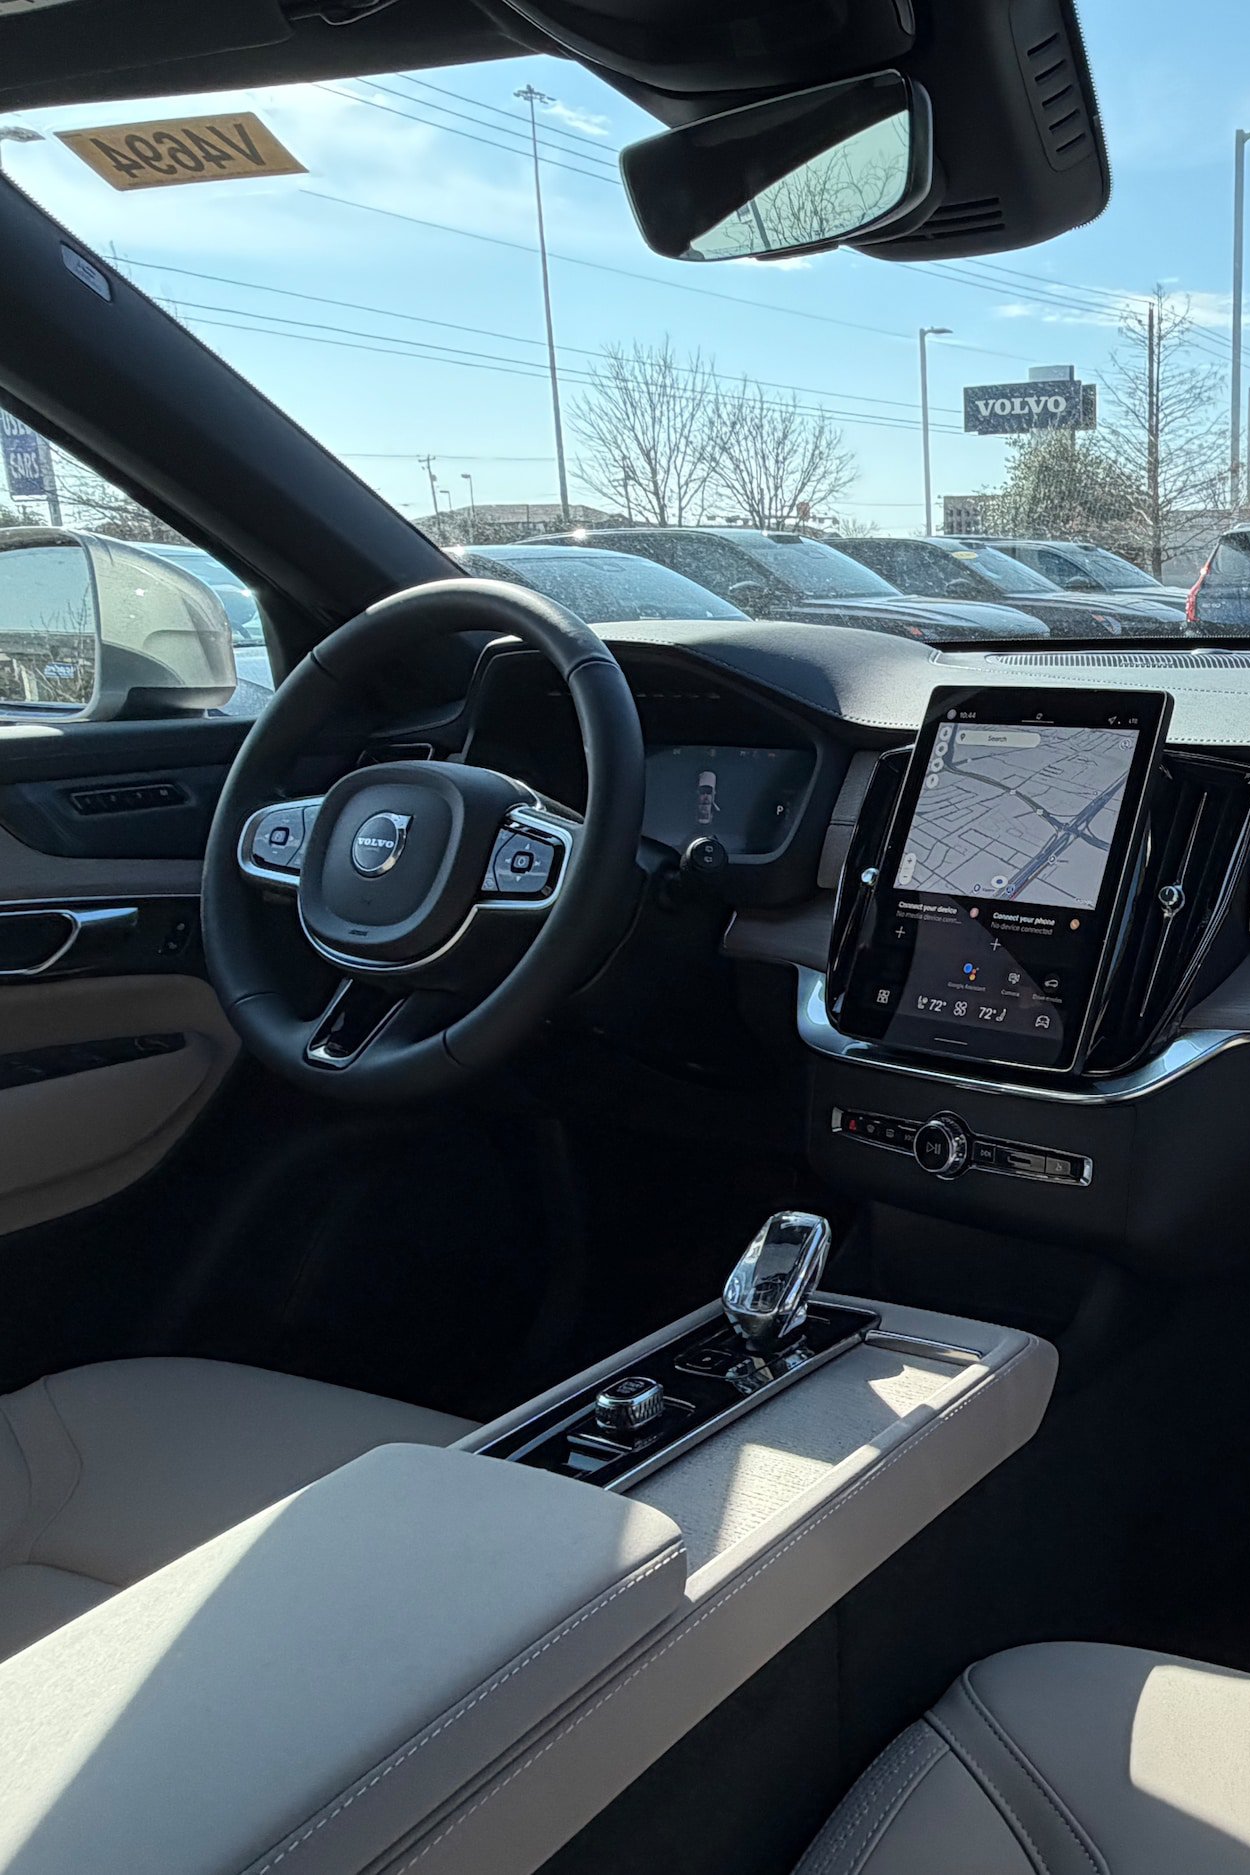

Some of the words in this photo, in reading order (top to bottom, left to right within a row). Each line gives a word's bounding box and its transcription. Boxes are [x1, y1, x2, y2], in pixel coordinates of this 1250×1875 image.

[975, 395, 1067, 417] VOLVO
[2, 412, 31, 436] USE
[9, 452, 40, 479] CARS
[988, 735, 1008, 743] Search
[776, 805, 784, 816] P
[357, 837, 395, 849] VOLVO
[898, 901, 922, 911] Connect
[923, 904, 937, 912] your
[937, 905, 958, 914] device
[993, 912, 1019, 922] Connect
[1020, 916, 1034, 925] your
[1034, 917, 1055, 926] phone
[991, 921, 1000, 929] No
[1000, 922, 1020, 932] device
[1020, 925, 1053, 936] connected
[929, 999, 947, 1012] 72°
[978, 1007, 997, 1020] 72°
